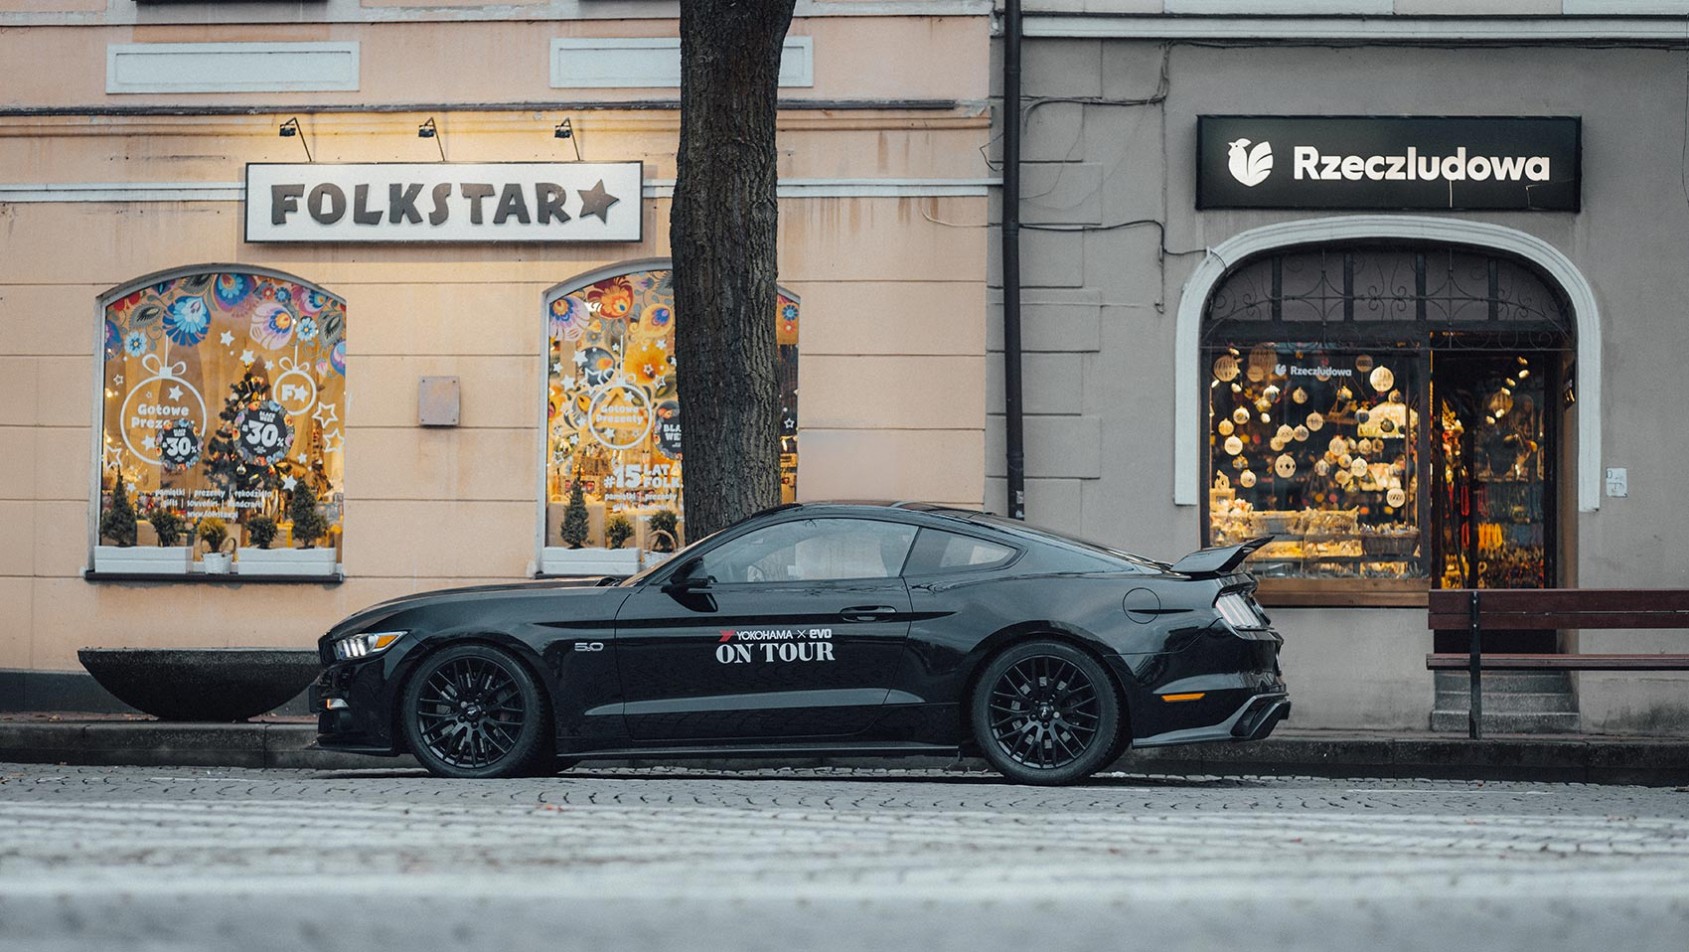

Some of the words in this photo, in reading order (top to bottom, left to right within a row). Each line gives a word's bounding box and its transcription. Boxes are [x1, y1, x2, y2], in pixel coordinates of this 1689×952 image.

[1293, 146, 1550, 182] Rzeczludowa
[270, 182, 572, 225] FOLKSTAR
[1290, 366, 1352, 377] Rzeczludowa
[137, 404, 189, 416] Gotowe
[601, 405, 639, 414] Gotowe
[596, 414, 644, 425] Prezenty
[663, 424, 681, 432] BLA
[665, 432, 681, 441] WE
[643, 464, 671, 476] LAT
[736, 630, 793, 641] YOKOHAMA
[715, 643, 753, 664] ON
[759, 642, 836, 663] TOUR
